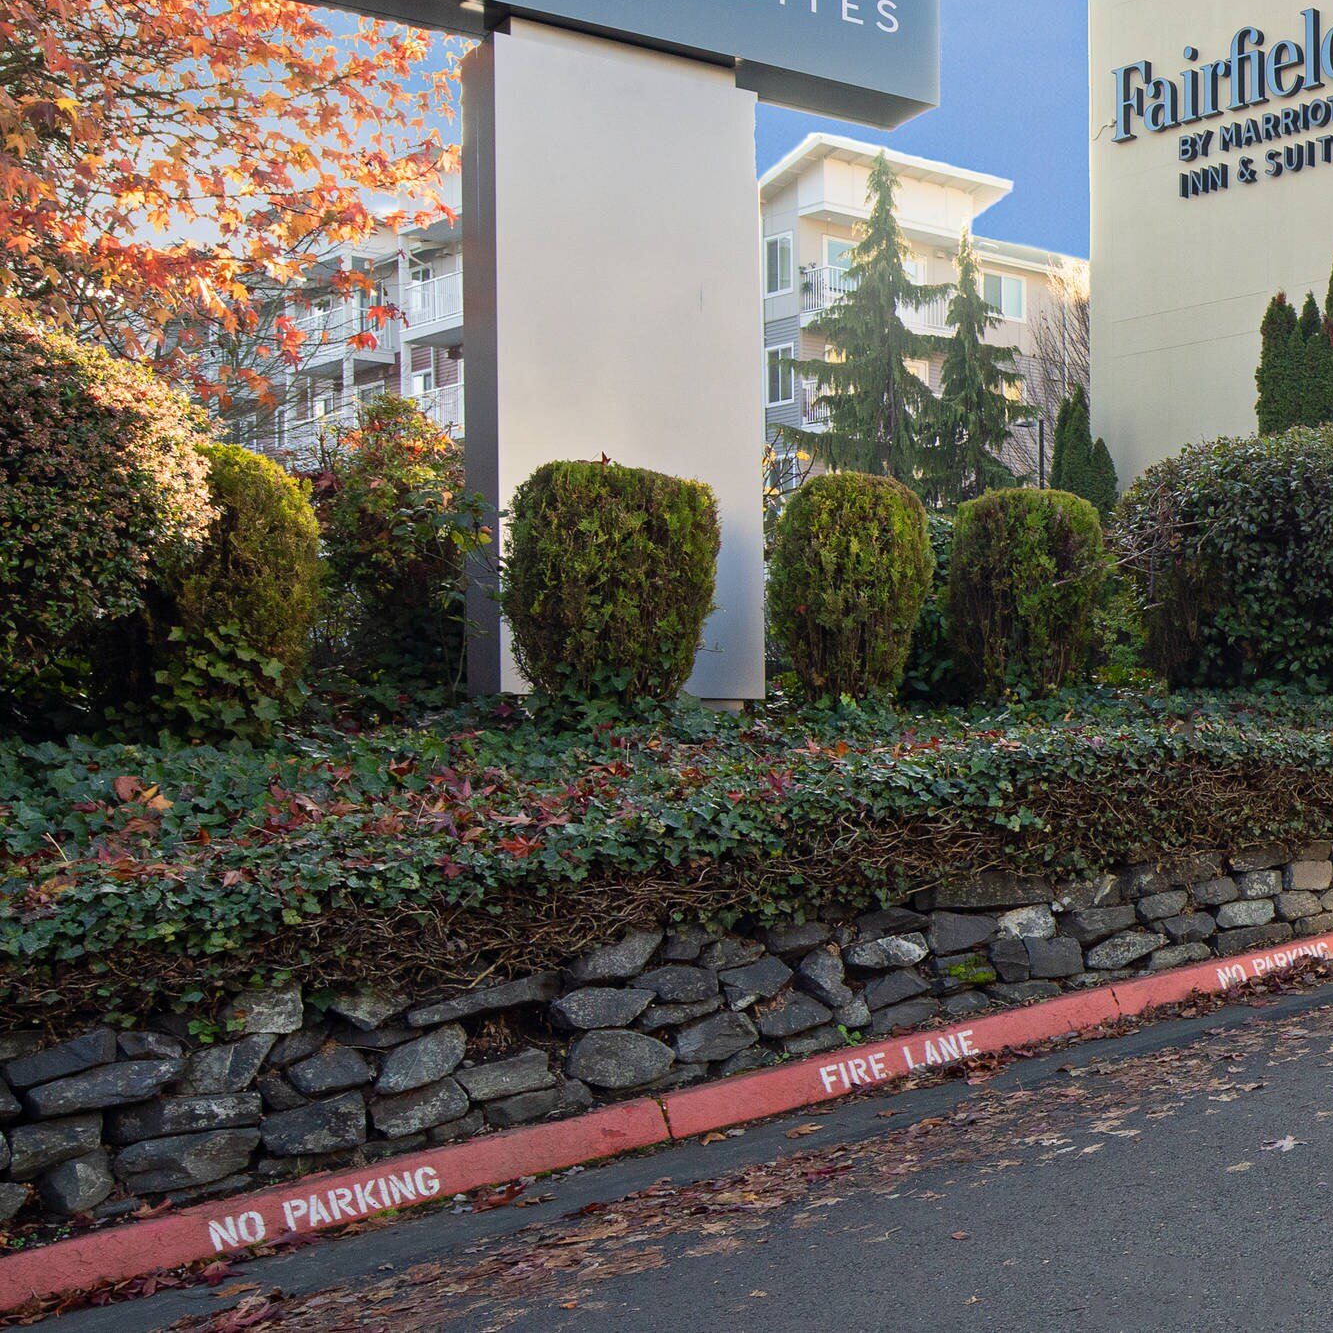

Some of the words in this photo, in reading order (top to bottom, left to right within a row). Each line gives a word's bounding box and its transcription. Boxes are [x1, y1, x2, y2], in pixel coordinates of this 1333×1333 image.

[1178, 130, 1214, 162] BY
[1178, 163, 1229, 198] INN
[1236, 156, 1258, 184] &
[1215, 964, 1247, 990] NO
[820, 1052, 891, 1093] FIRE
[902, 1029, 979, 1069] LANE
[208, 1211, 266, 1251] NO
[282, 1166, 441, 1231] PARKING
